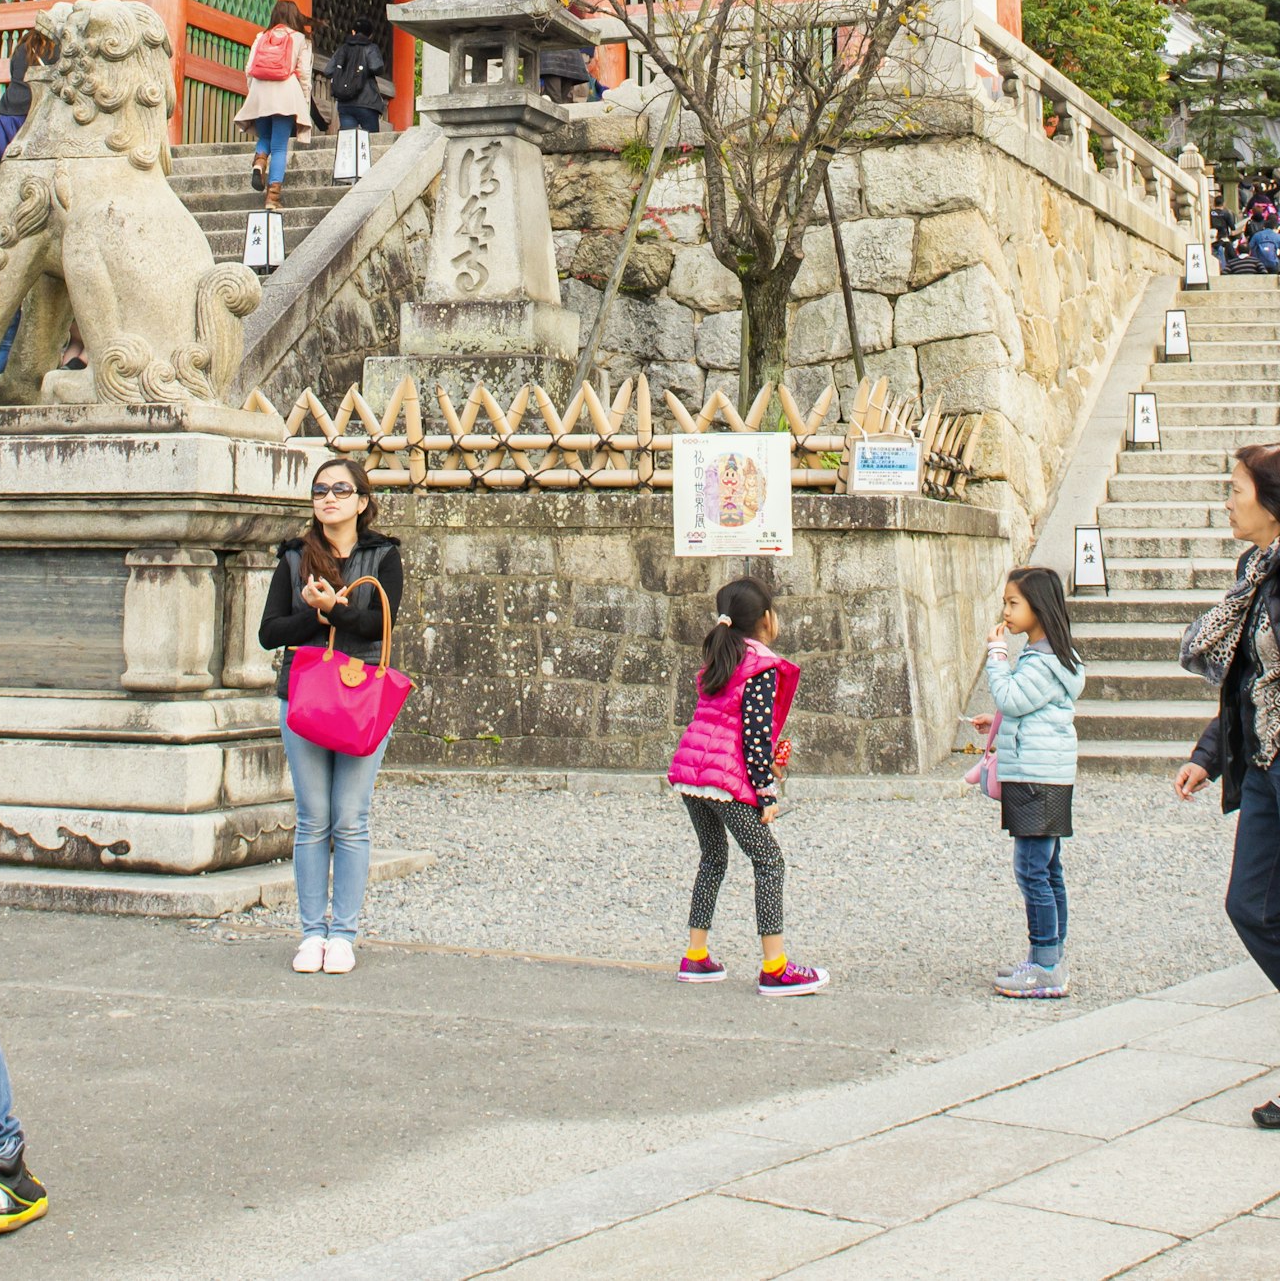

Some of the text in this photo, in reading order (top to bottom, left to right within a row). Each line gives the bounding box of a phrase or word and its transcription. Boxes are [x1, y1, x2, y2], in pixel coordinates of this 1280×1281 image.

[693, 450, 706, 529] 仏の世界展
